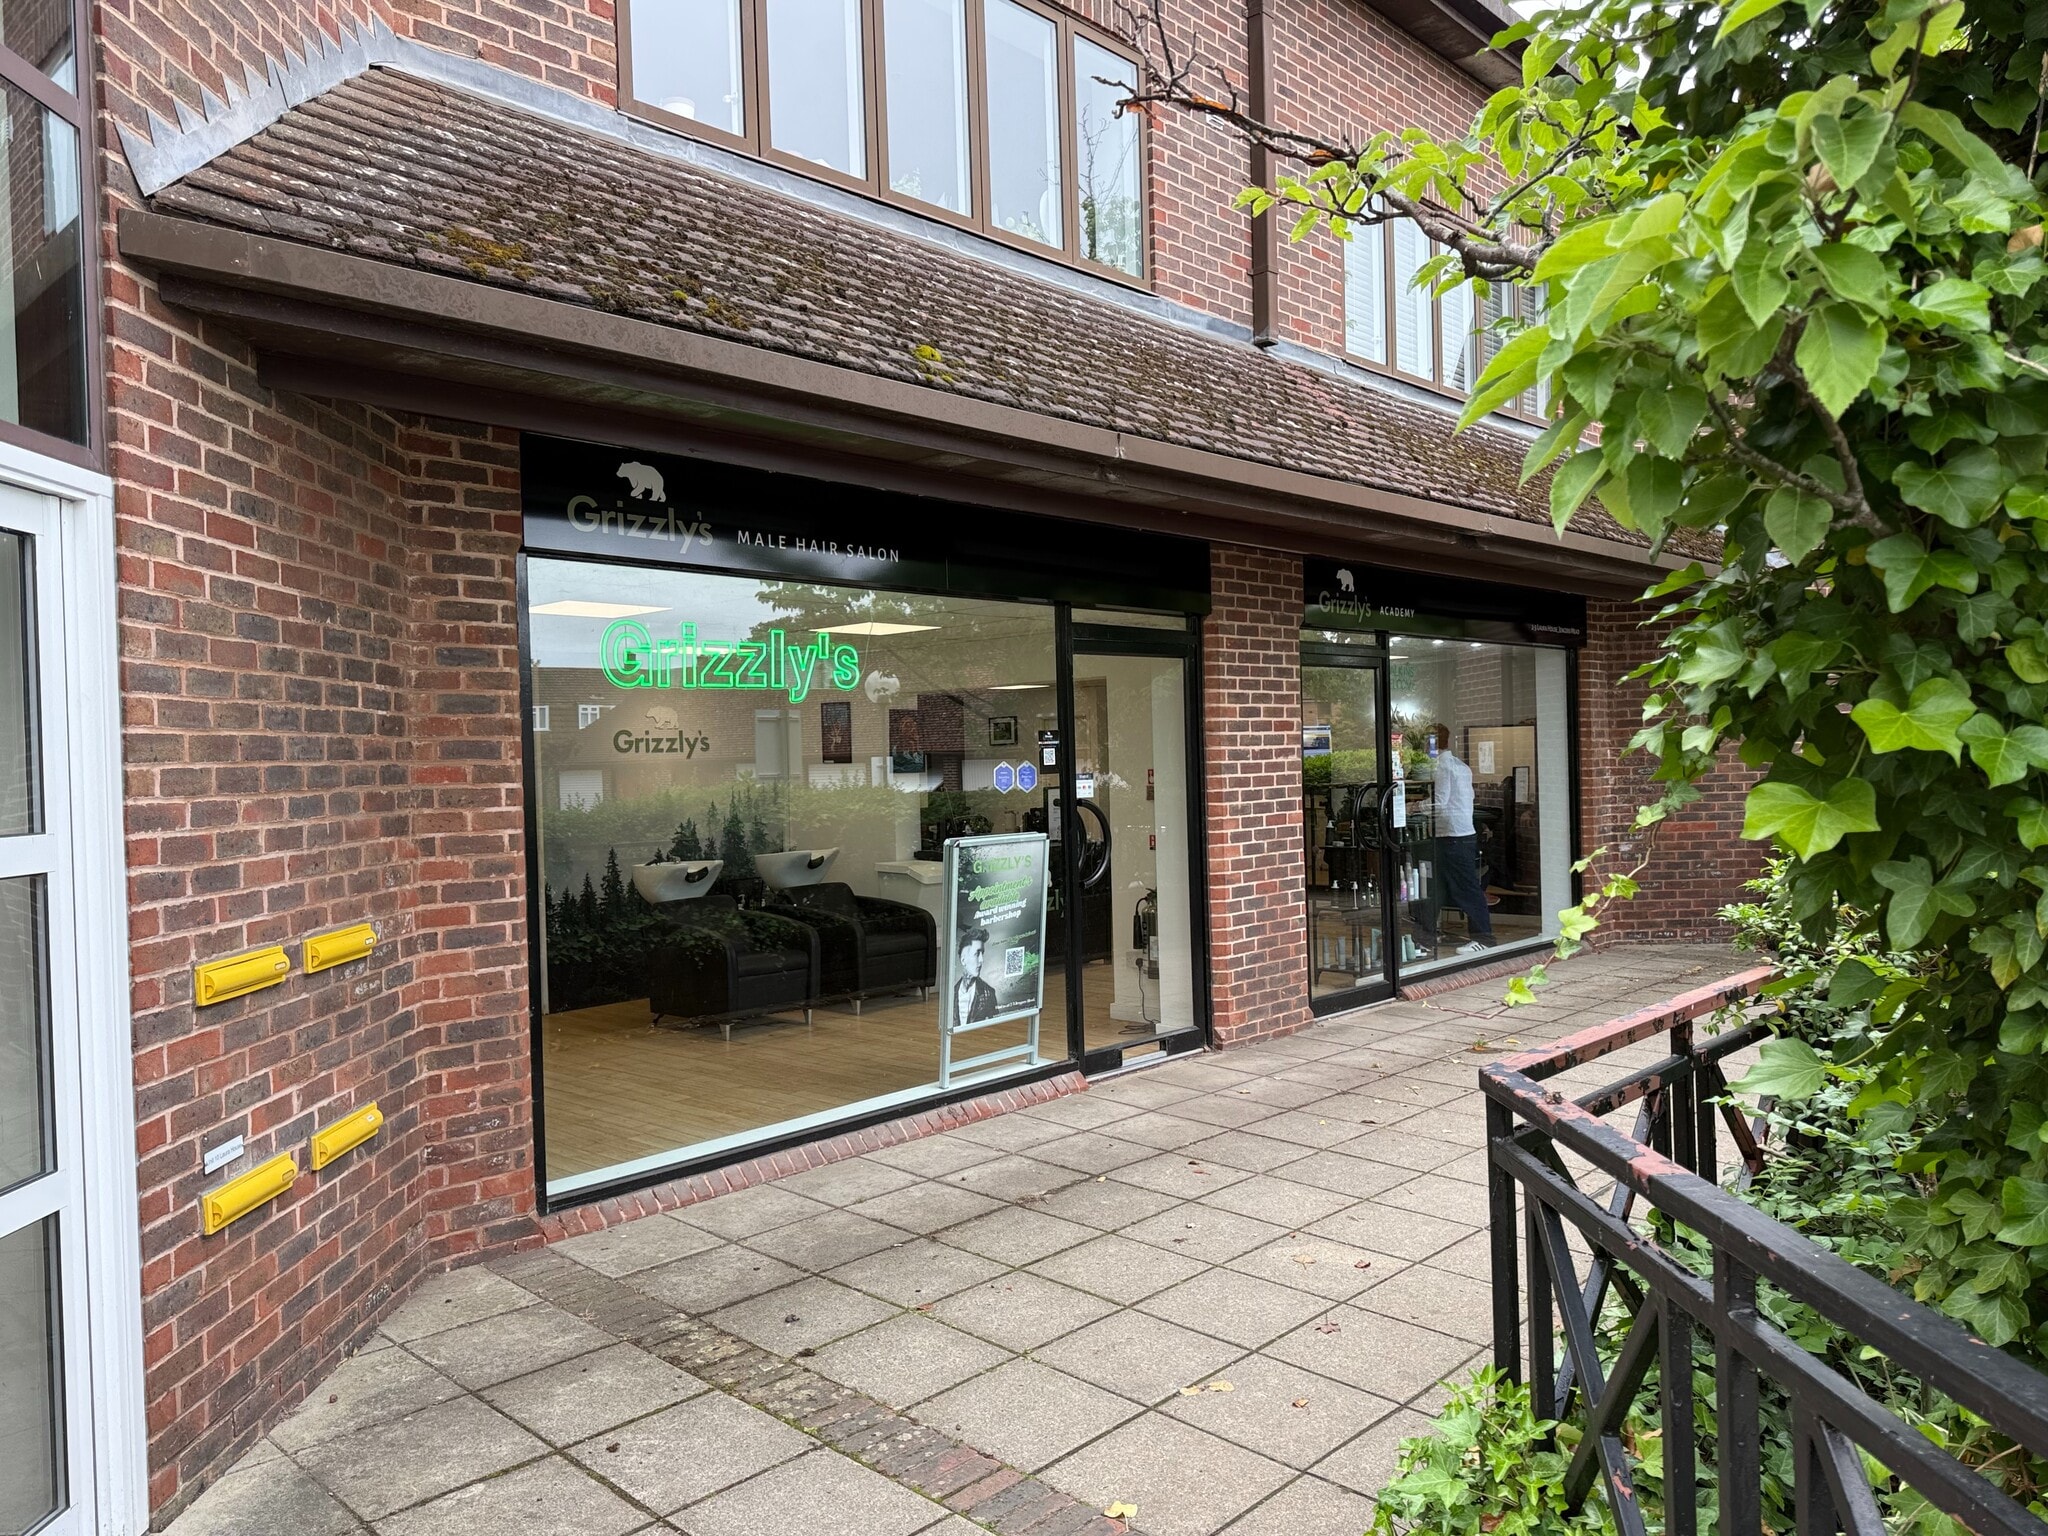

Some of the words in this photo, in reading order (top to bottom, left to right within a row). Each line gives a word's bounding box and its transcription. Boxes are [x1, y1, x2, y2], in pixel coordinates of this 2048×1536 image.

[567, 495, 714, 554] Grizzly's
[737, 530, 787, 550] MALE
[795, 538, 839, 556] HAIR
[846, 544, 900, 563] SALON
[1319, 590, 1372, 623] Grizzly's
[1379, 606, 1415, 618] ACADEMY
[600, 618, 860, 704] Grizzly's
[613, 730, 710, 759] Grizzly's
[973, 906, 998, 919] Award
[998, 898, 1027, 913] winning
[980, 910, 1021, 926] barbershop
